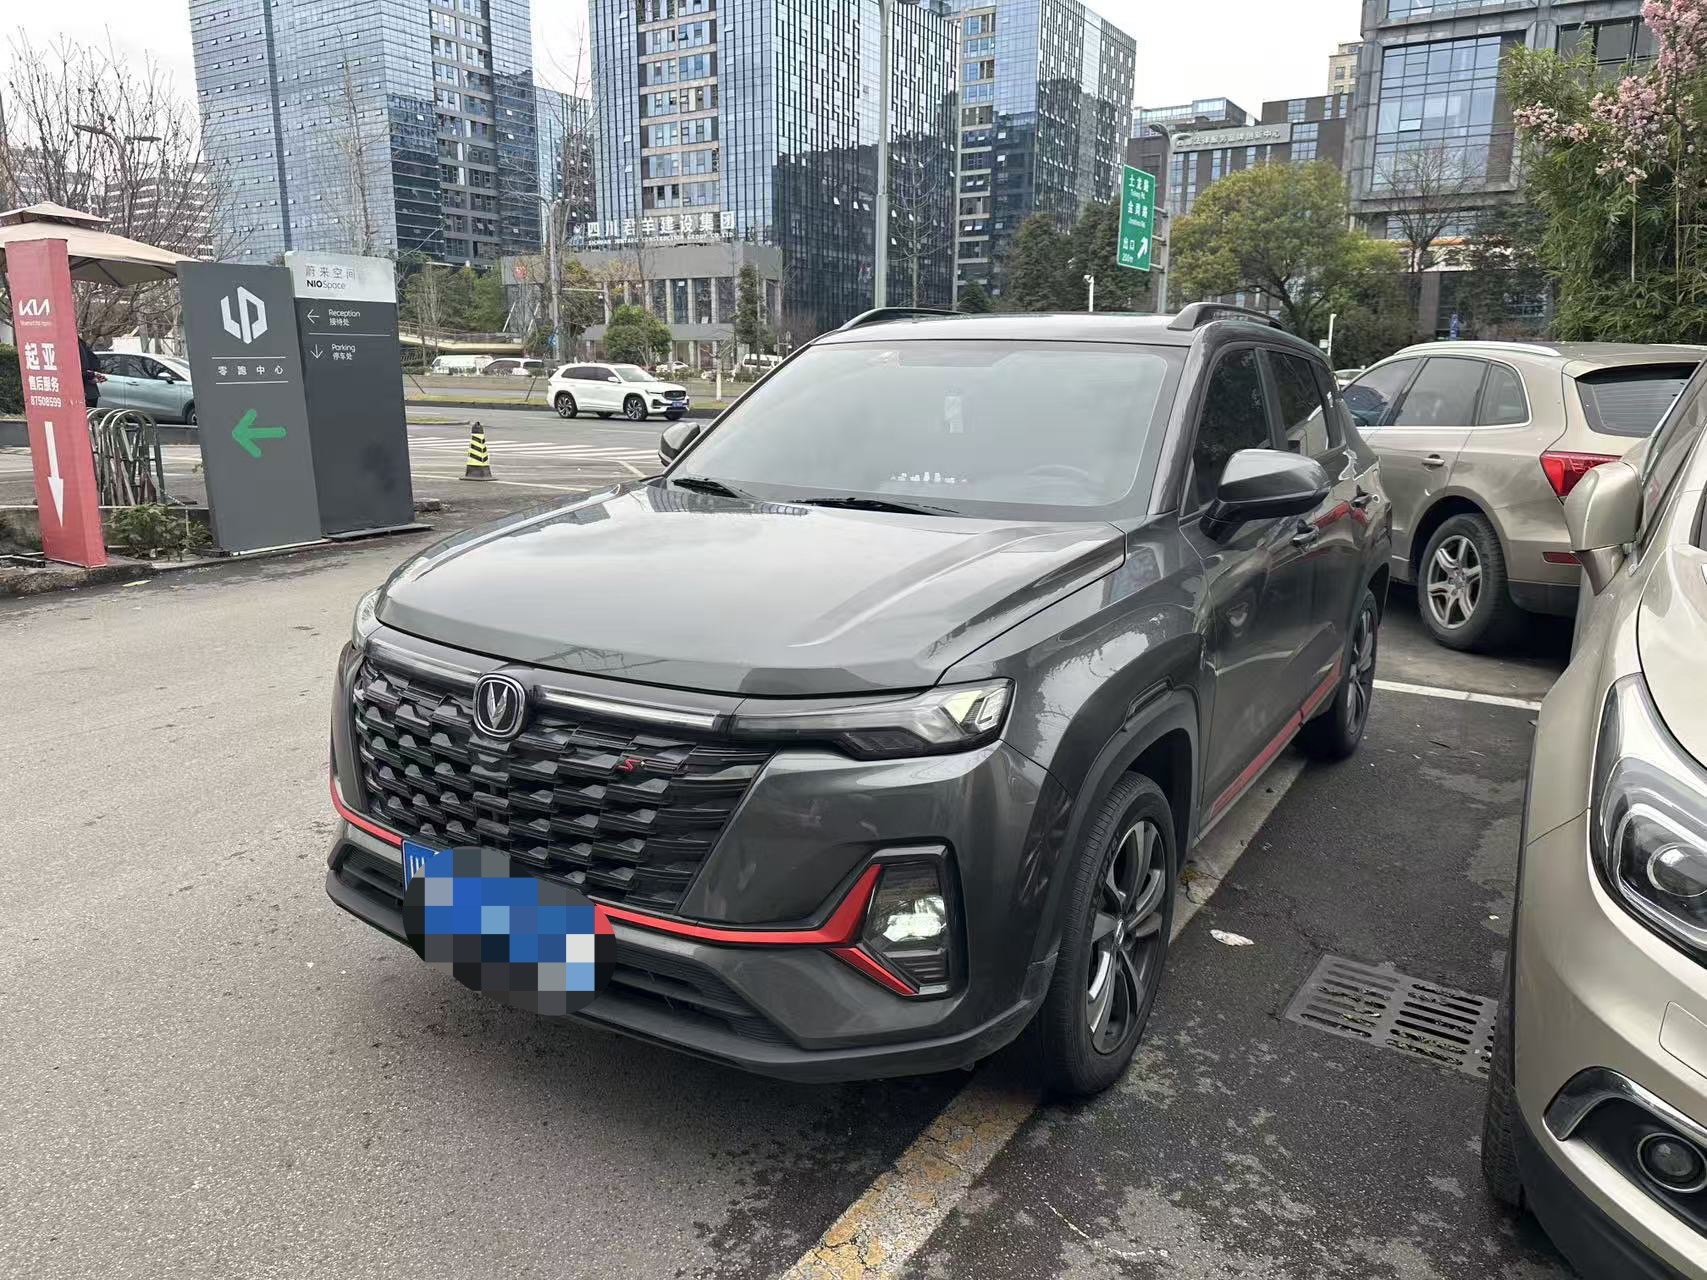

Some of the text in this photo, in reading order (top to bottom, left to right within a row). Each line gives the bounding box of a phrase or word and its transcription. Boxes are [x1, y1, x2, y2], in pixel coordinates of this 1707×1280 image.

[587, 211, 735, 238] 四川君羊建设集团
[304, 264, 356, 280] 蔚来空间
[328, 309, 361, 317] Reception
[329, 318, 351, 326] 接待处
[331, 344, 356, 352] Parking
[25, 342, 57, 371] 起亚
[332, 352, 353, 360] 停车处
[218, 365, 283, 376] 零跑中心
[28, 375, 59, 392] 售后服务
